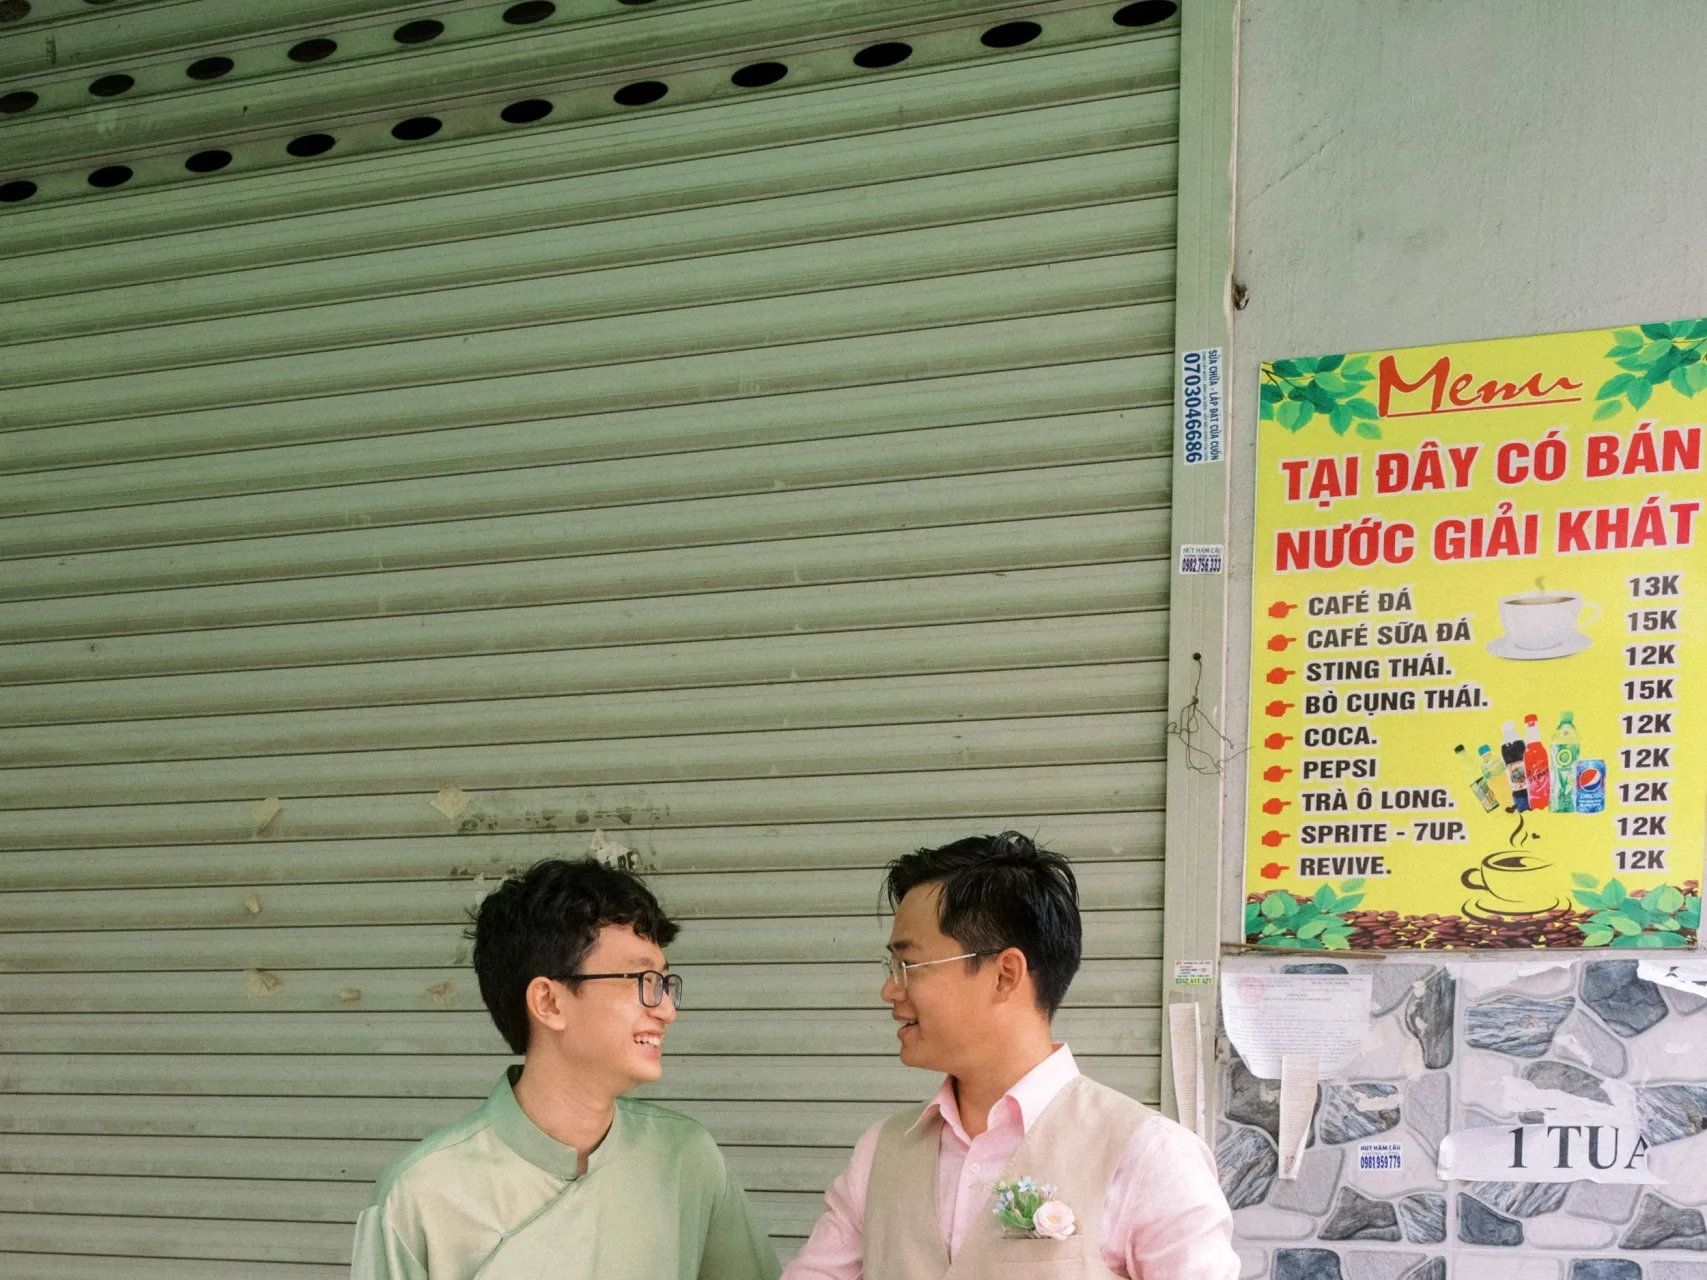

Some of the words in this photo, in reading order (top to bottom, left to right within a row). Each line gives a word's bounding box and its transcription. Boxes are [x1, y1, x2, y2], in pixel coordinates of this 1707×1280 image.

[1378, 354, 1583, 417] Menu
[1184, 353, 1202, 463] 0703046686
[1281, 456, 1359, 507] TẠI
[1376, 441, 1479, 494] ĐÂY
[1496, 430, 1566, 484] CÓ
[1586, 423, 1701, 478] BÁN
[1275, 519, 1415, 571] NƯỚC
[1433, 502, 1538, 560] GIẢI
[1558, 497, 1700, 553] KHÁT
[1308, 590, 1369, 616] CAFÉ
[1378, 588, 1412, 612] ĐÁ
[1629, 575, 1680, 597] 13K
[1307, 624, 1368, 649] CAFÉ
[1377, 621, 1428, 645] SỮA
[1436, 618, 1471, 642] ĐÁ
[1628, 610, 1677, 631] 15K
[1306, 660, 1380, 682] STING
[1389, 653, 1452, 678] THÁI.
[1626, 644, 1675, 666] 12K
[1305, 691, 1338, 714] BÒ
[1347, 691, 1415, 716] CỤNG
[1425, 685, 1488, 709] THÁI.
[1624, 679, 1674, 700] 15K
[1304, 726, 1378, 747] COCA.
[1622, 714, 1672, 734] 12K
[1303, 759, 1376, 780] PEPSI
[1620, 748, 1670, 768] 12K
[1302, 789, 1348, 812] TRÀ
[1357, 788, 1372, 810] Ô
[1382, 789, 1454, 810] LONG.
[1619, 782, 1668, 802] 12K
[1301, 824, 1388, 844] SPRITE
[1414, 822, 1466, 841] 7UP.
[1617, 816, 1666, 836] 12K
[1300, 856, 1392, 876] REVIVE.
[1616, 850, 1665, 870] 12K
[1508, 1126, 1528, 1168] 1
